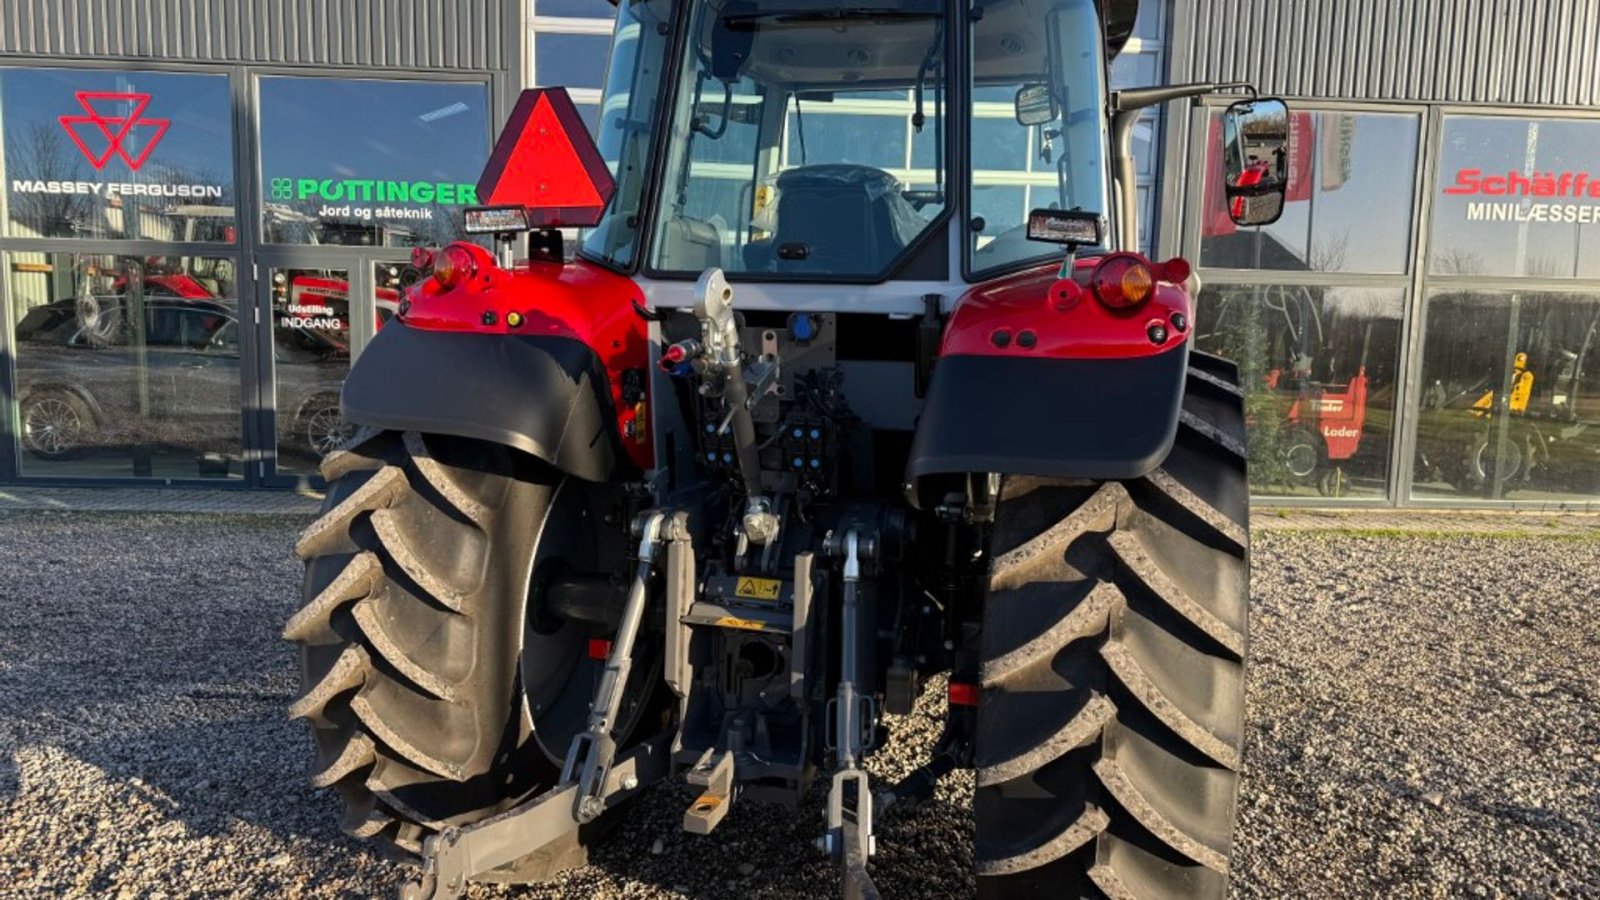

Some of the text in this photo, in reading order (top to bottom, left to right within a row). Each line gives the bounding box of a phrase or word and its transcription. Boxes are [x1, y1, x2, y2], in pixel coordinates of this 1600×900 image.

[13, 180, 222, 197] MASSEY FERGUSON
[319, 205, 433, 220] Jord og såteknik
[281, 317, 341, 329] INDGANG
